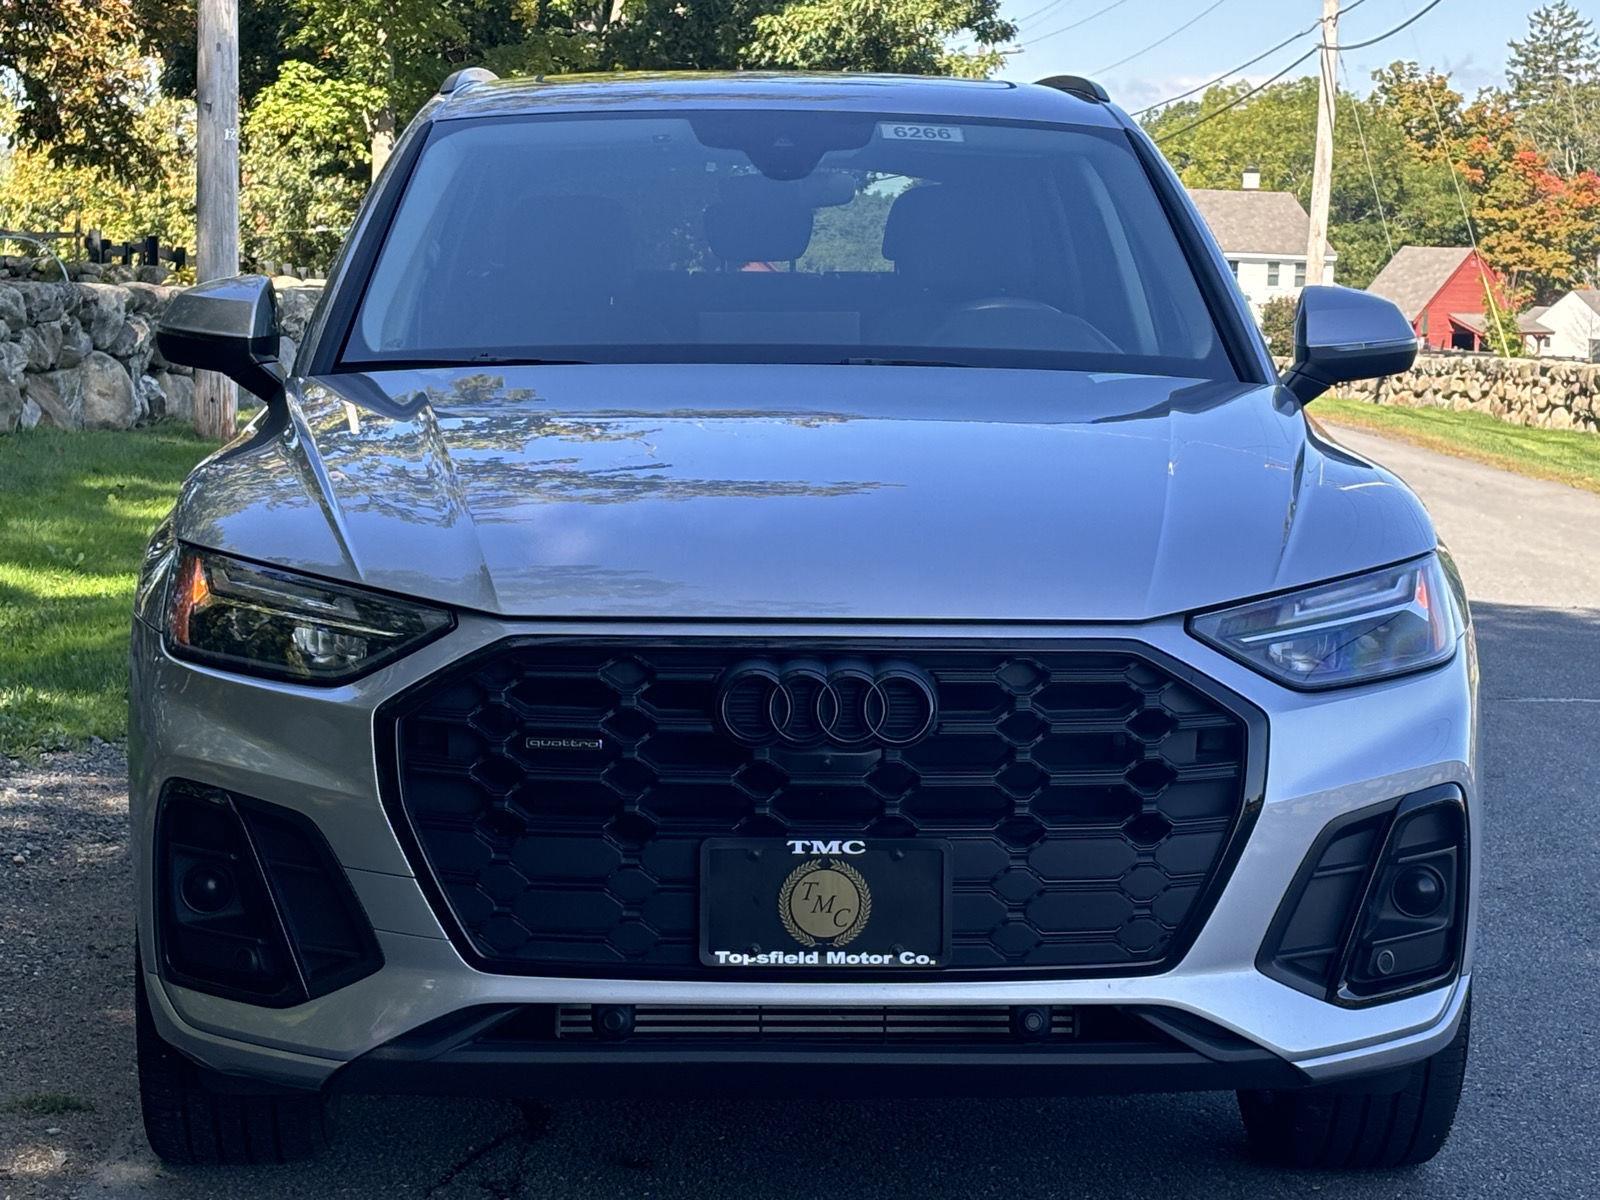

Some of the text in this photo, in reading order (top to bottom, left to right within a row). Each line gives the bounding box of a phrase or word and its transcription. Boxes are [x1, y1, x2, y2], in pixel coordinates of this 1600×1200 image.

[893, 126, 951, 140] 6266
[528, 738, 600, 749] quattro
[786, 840, 866, 855] TMC
[714, 950, 936, 965] Topsfield Motor Co.
